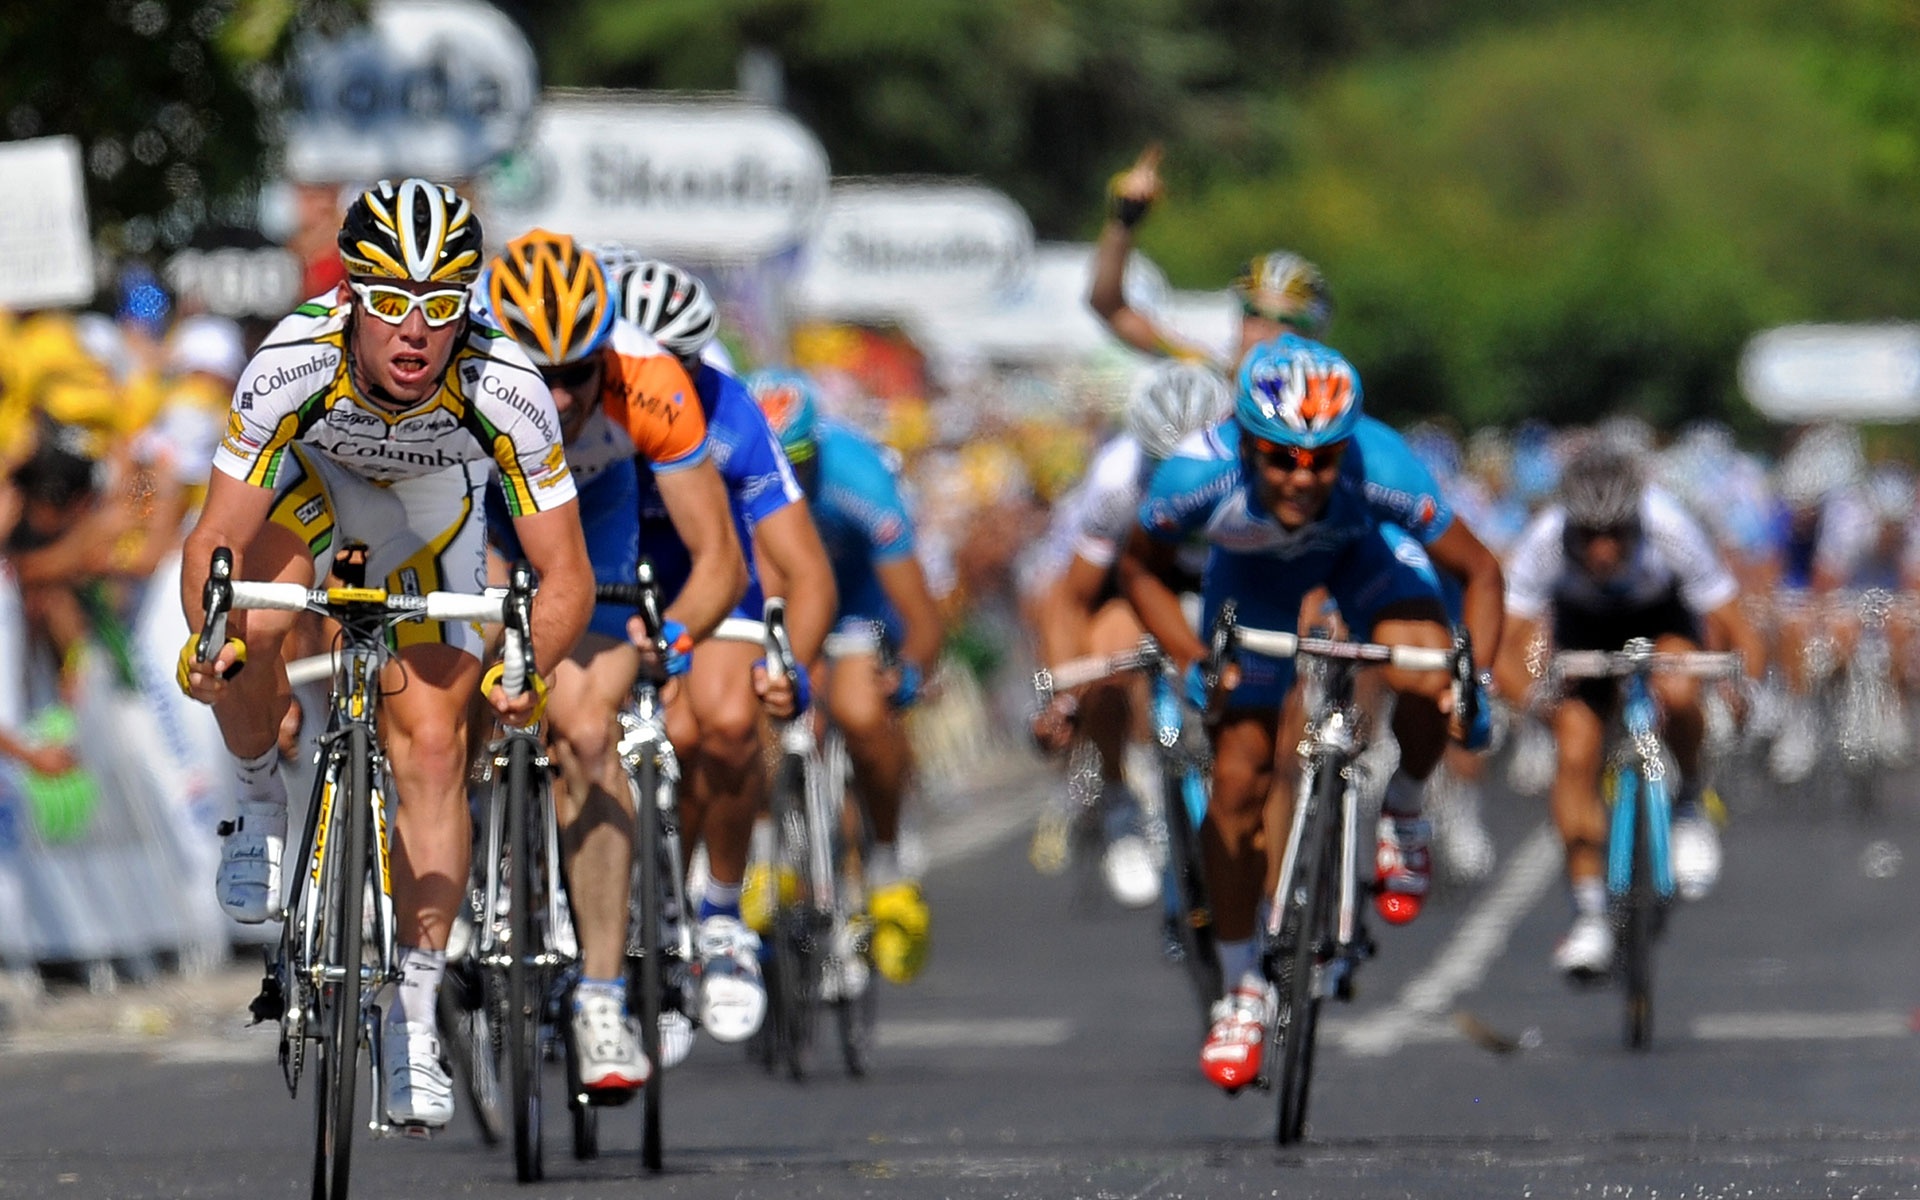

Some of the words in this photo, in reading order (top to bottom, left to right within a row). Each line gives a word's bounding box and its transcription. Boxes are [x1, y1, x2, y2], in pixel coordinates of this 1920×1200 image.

[253, 352, 337, 396] Columbia
[482, 375, 554, 442] Columbia
[331, 441, 464, 467] Columbi
